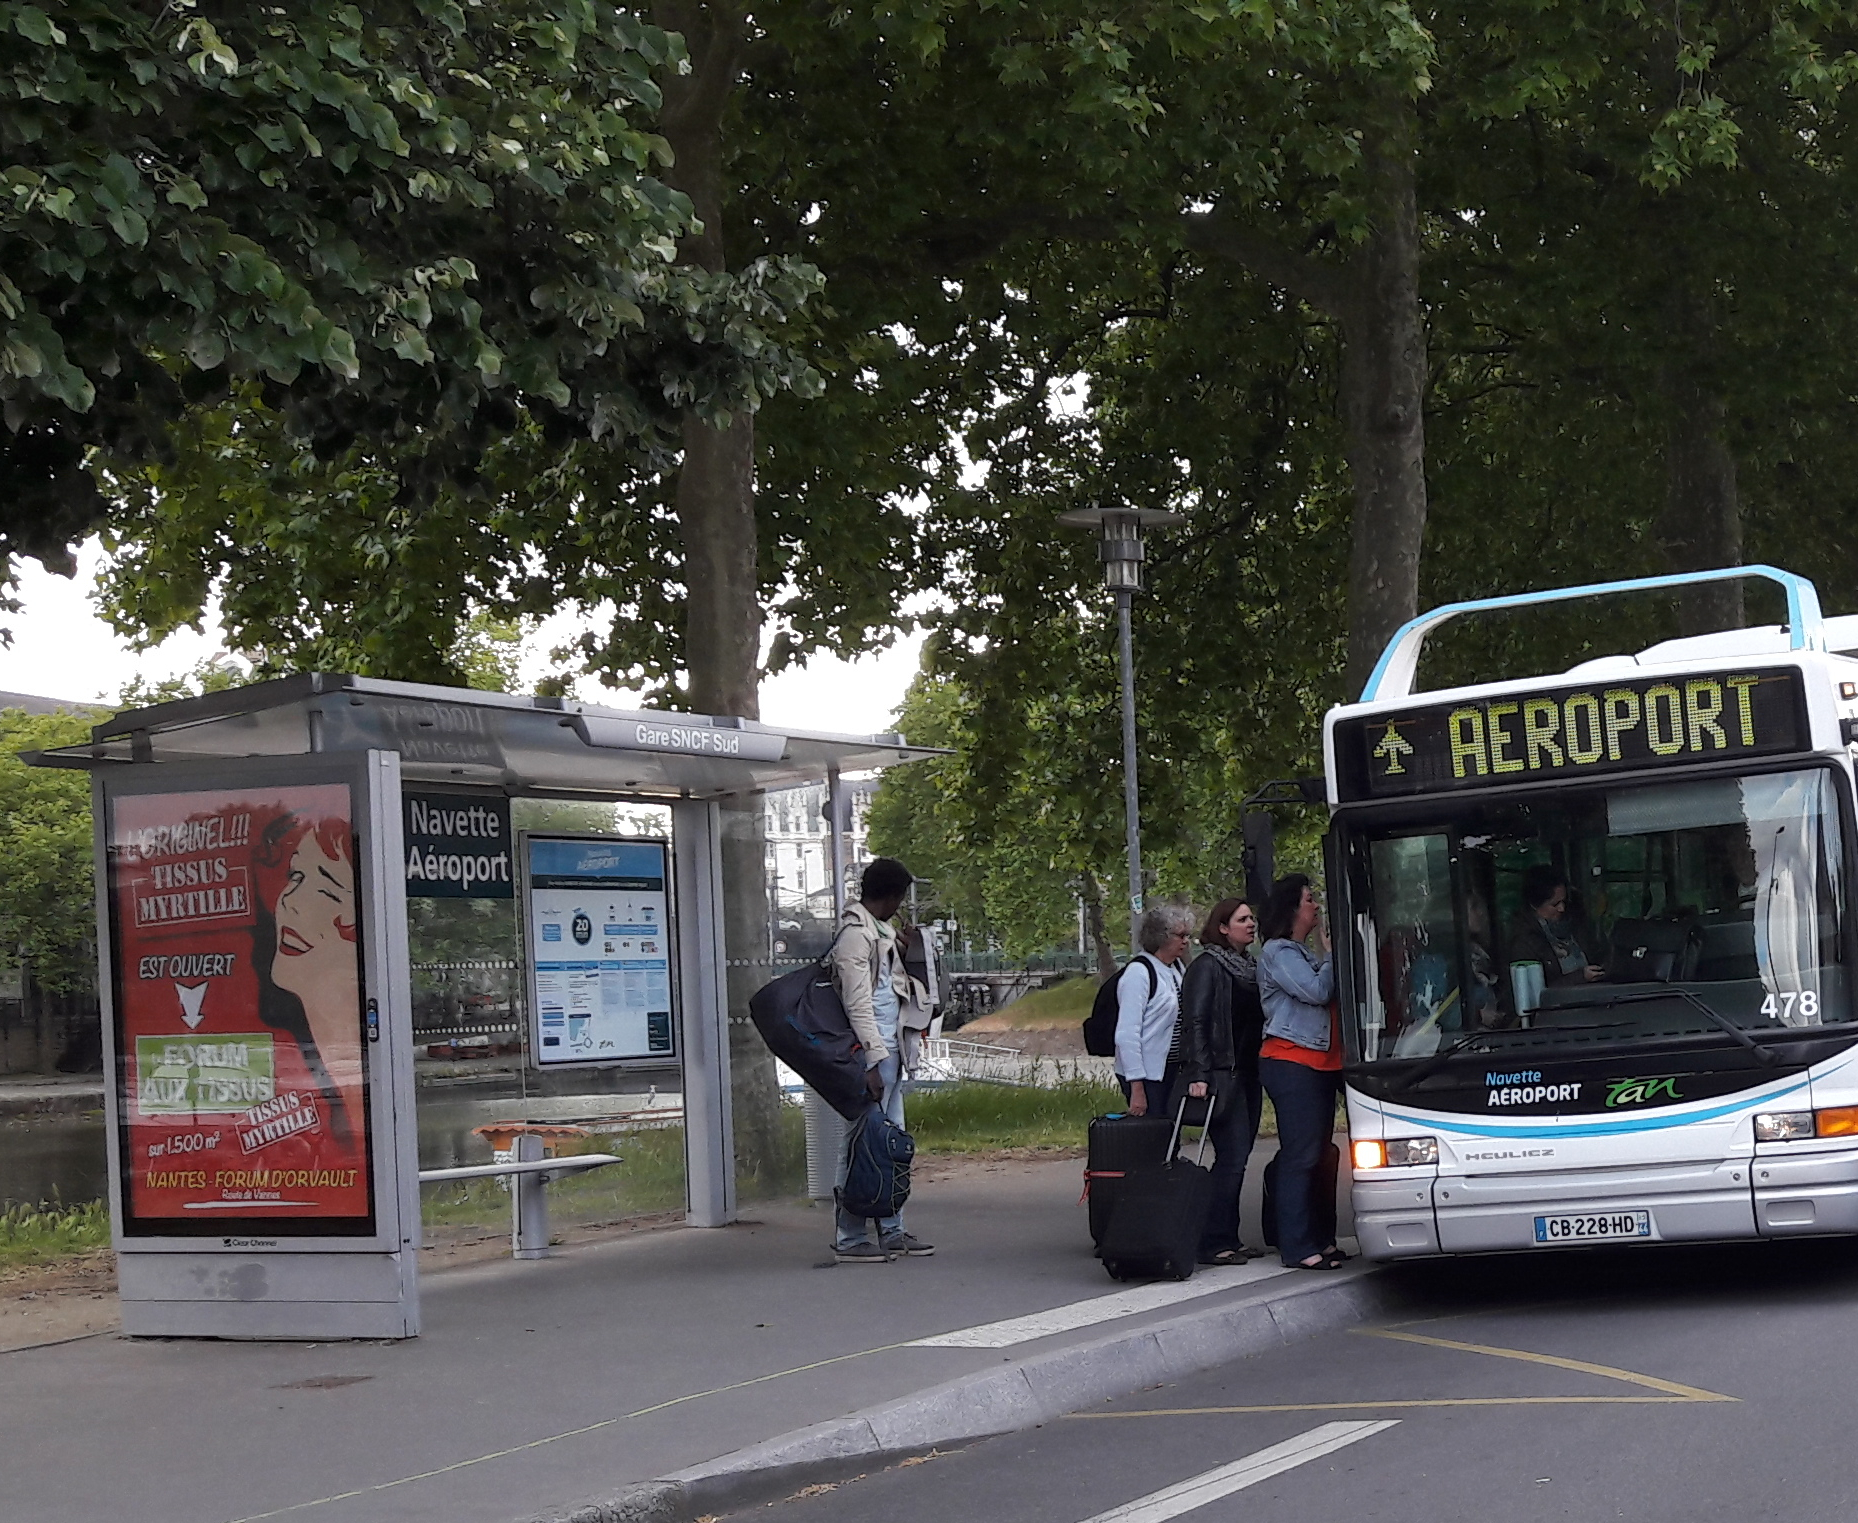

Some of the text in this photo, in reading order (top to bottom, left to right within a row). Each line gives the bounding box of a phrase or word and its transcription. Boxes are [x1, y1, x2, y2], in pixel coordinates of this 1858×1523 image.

[636, 724, 740, 754] Gare SNCF Sud
[1447, 675, 1760, 779] AEROPORT
[410, 800, 500, 838] Navette
[151, 857, 229, 890] TISSUS
[407, 845, 510, 891] Aéroport
[139, 885, 247, 922] MYRTILLE
[576, 918, 589, 932] 20
[139, 953, 236, 979] EST OUVERT
[1760, 990, 1819, 1020] 478
[164, 1042, 250, 1068] FORUM
[141, 1076, 274, 1102] AUX TISSUS
[1485, 1070, 1542, 1087] Navette
[1604, 1077, 1685, 1108] tan
[245, 1090, 300, 1127] TISSUS
[1487, 1083, 1582, 1107] AÉROPORT
[242, 1106, 317, 1150] MYRTILLE
[148, 1143, 166, 1158] sur
[146, 1170, 207, 1189] NANTES
[215, 1171, 268, 1188] FORUM
[271, 1169, 358, 1188] D'ORVAULT
